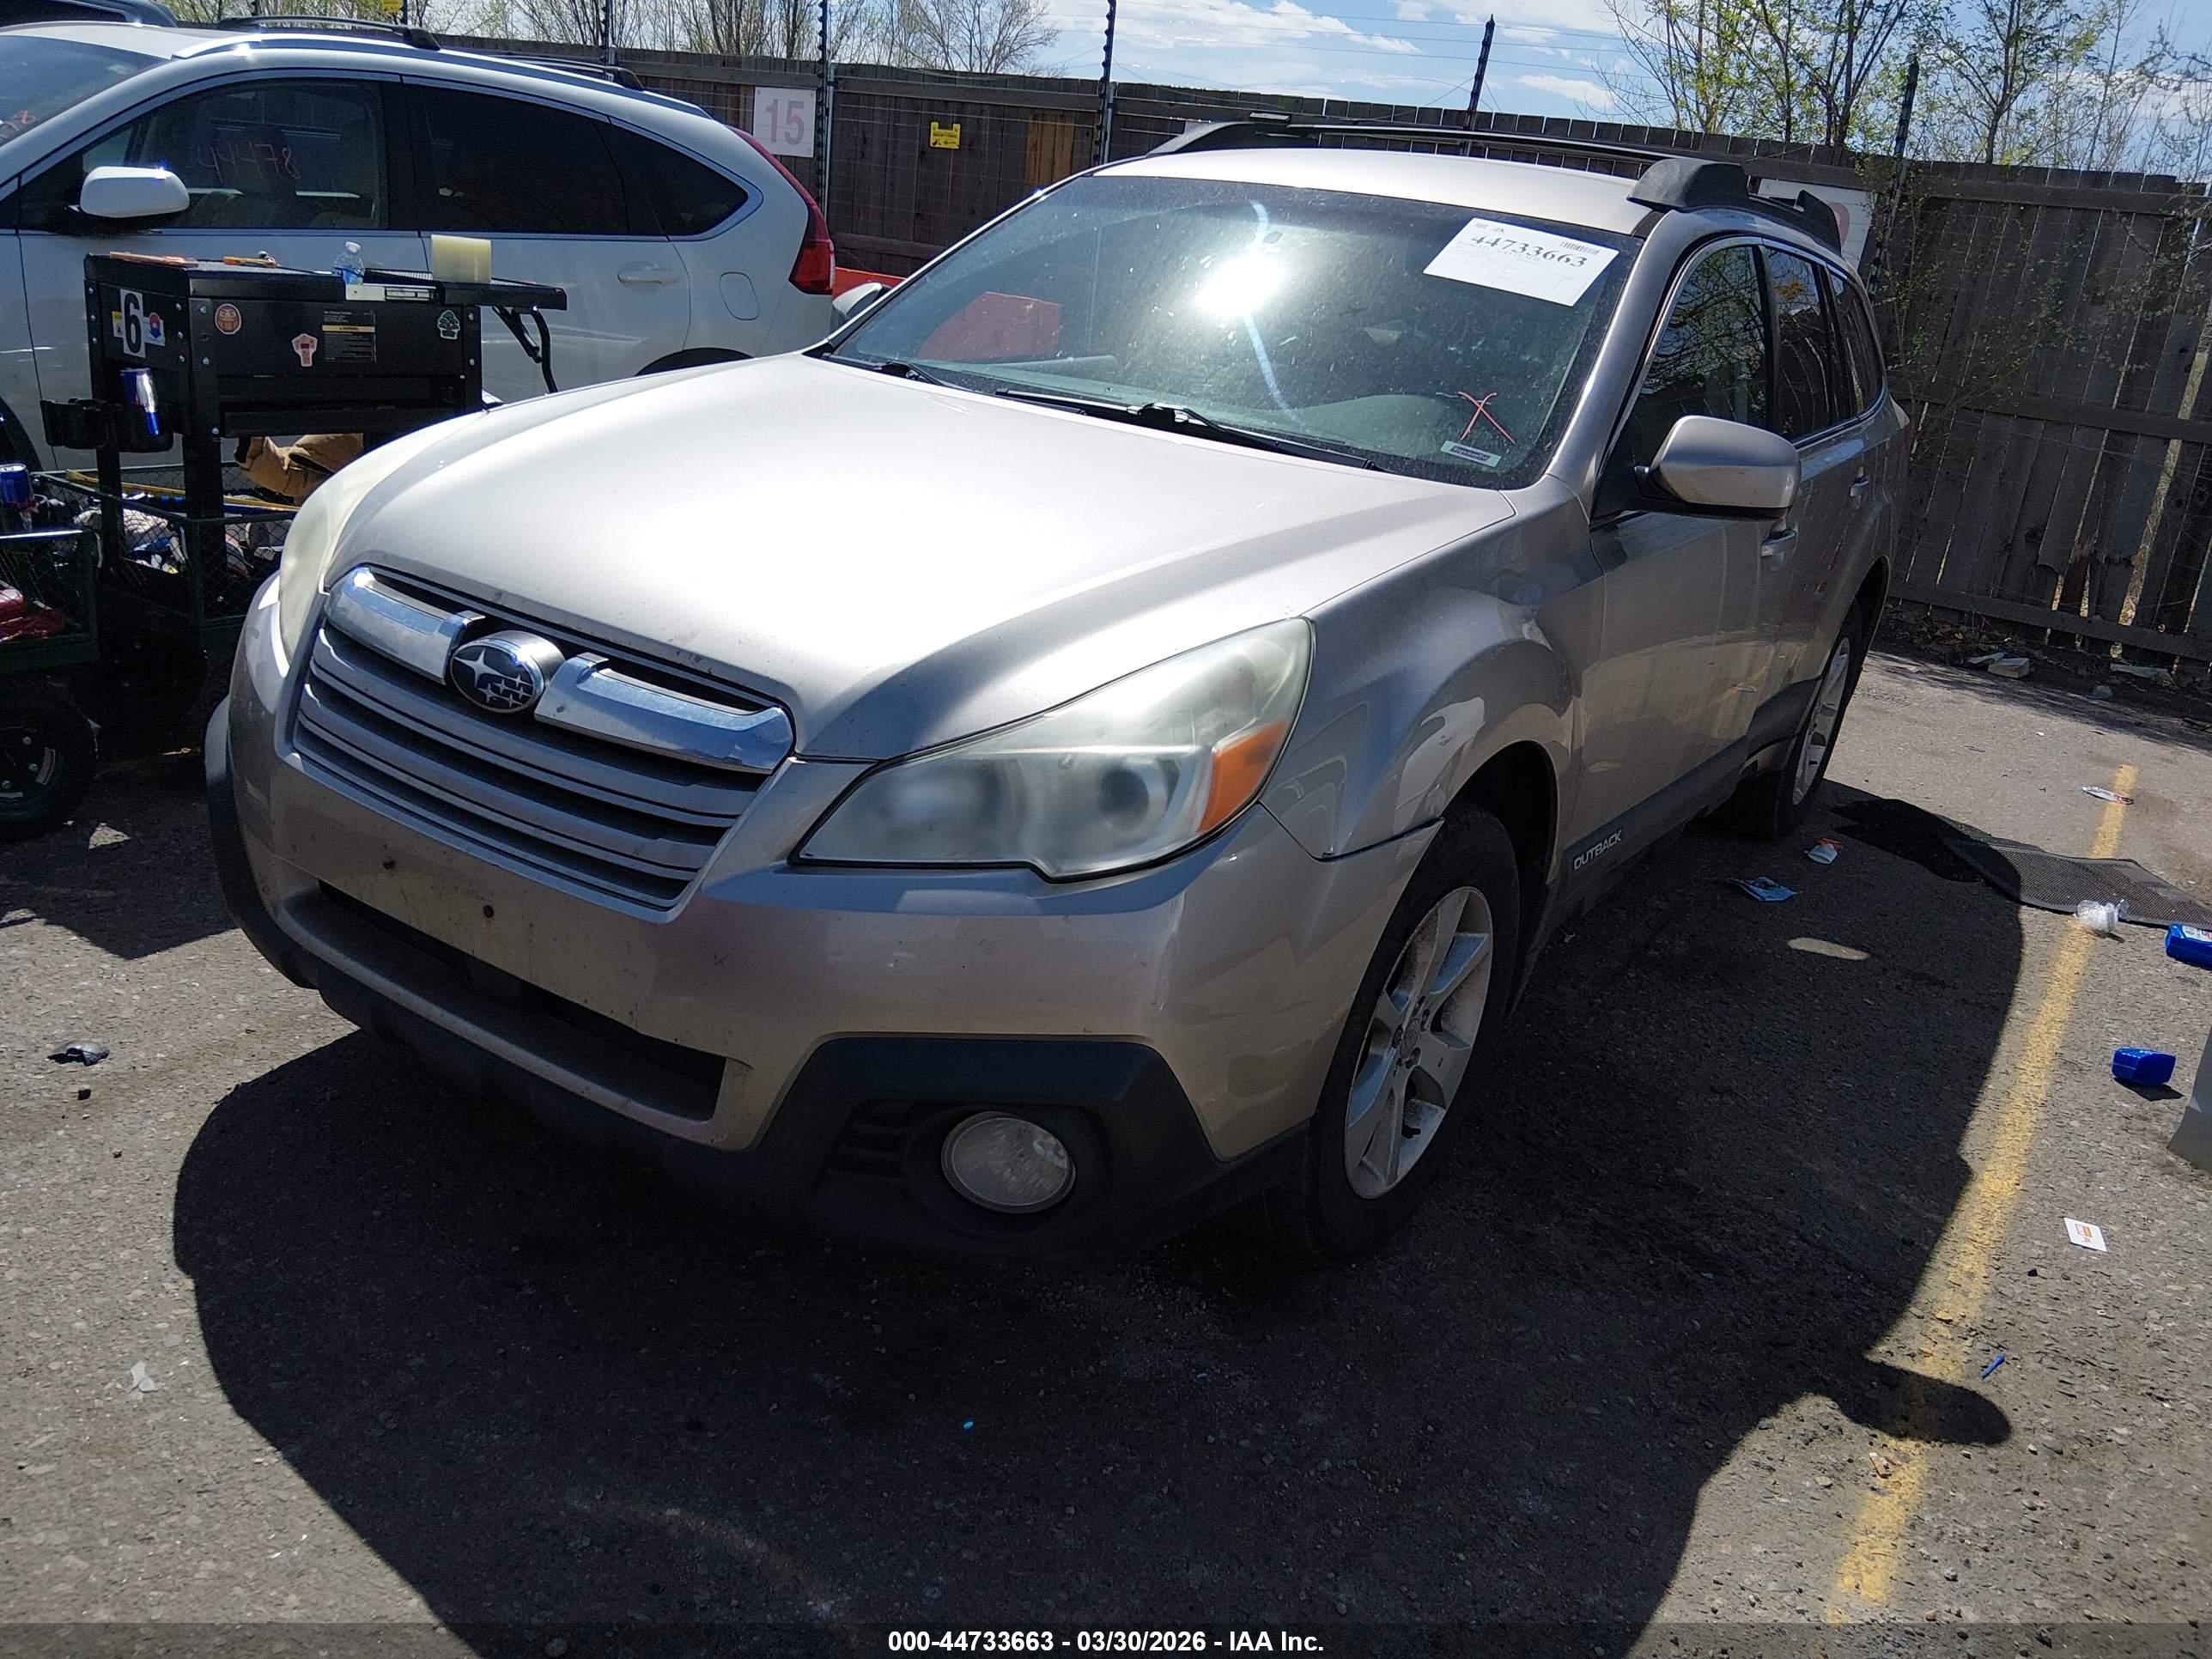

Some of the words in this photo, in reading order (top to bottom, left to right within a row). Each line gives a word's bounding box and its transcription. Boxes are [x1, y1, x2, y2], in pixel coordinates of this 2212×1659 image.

[765, 99, 805, 145] 15
[1471, 234, 1587, 267] 44733663
[125, 293, 142, 354] 6
[1574, 830, 1622, 870] OUTBACK
